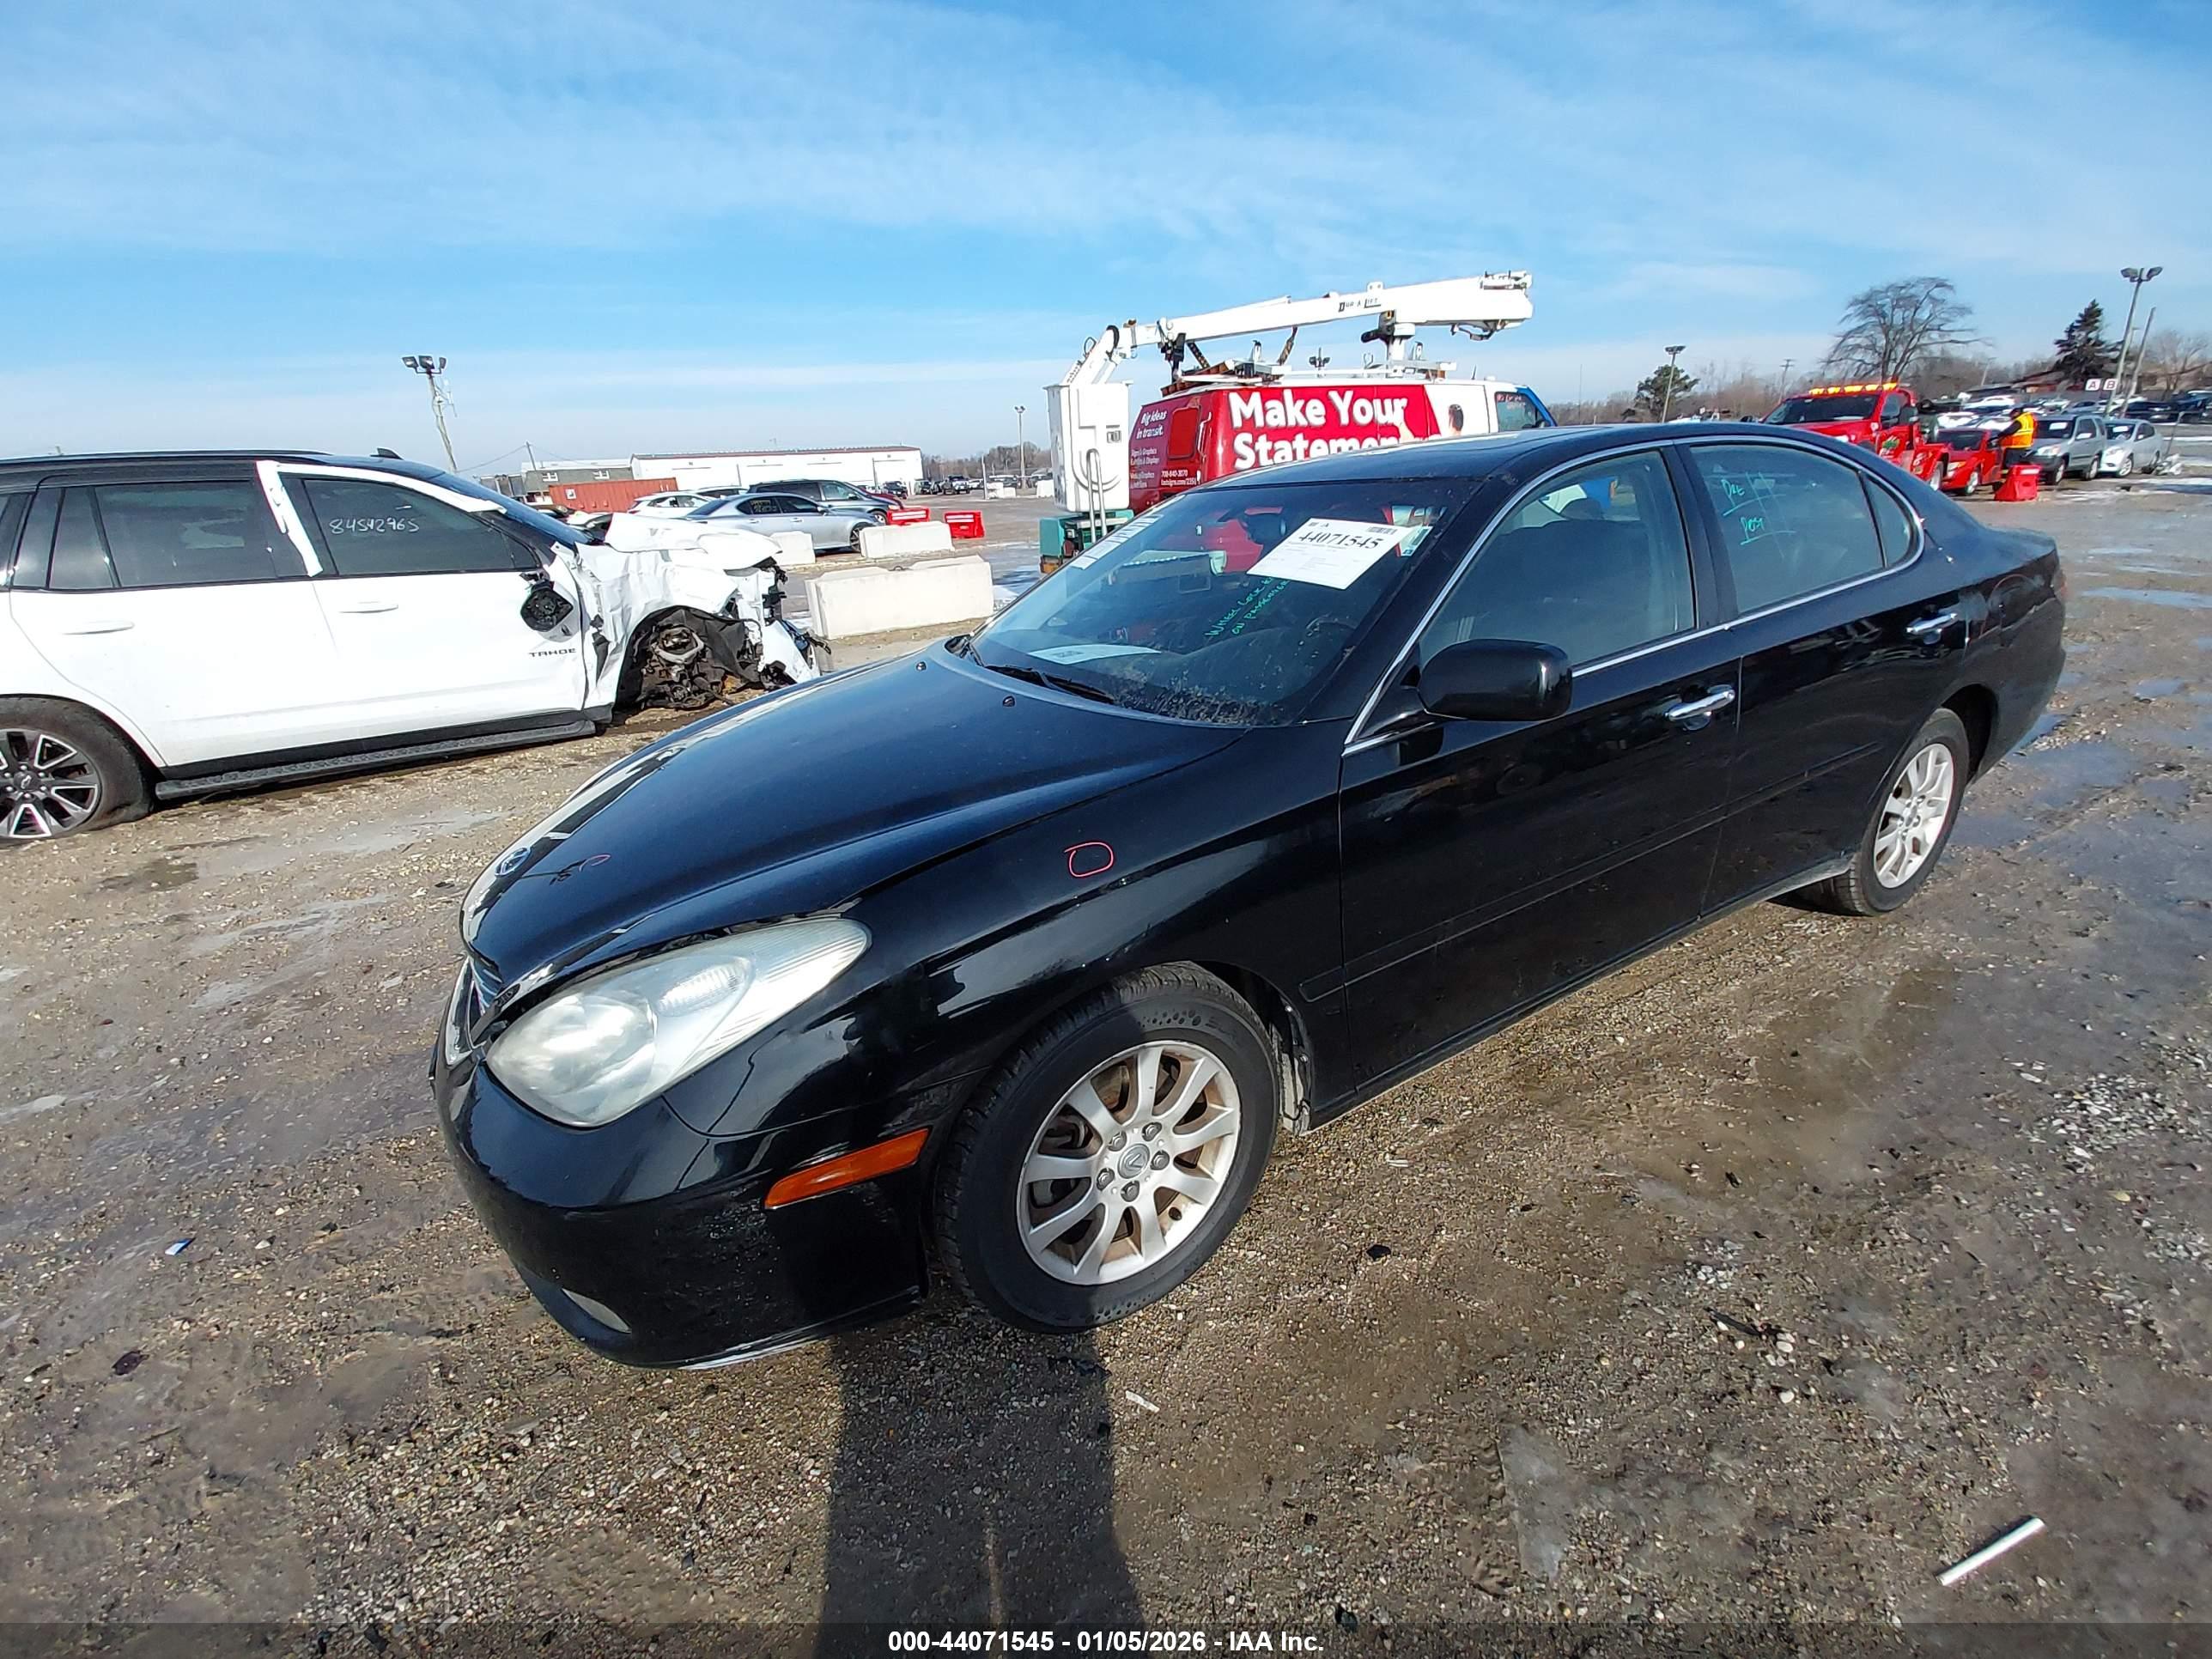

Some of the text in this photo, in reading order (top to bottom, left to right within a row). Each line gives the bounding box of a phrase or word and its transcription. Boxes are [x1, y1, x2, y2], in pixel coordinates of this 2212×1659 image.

[1229, 389, 1408, 428] Make Your
[1298, 531, 1383, 550] 44071545
[529, 648, 576, 658] TAHOE
